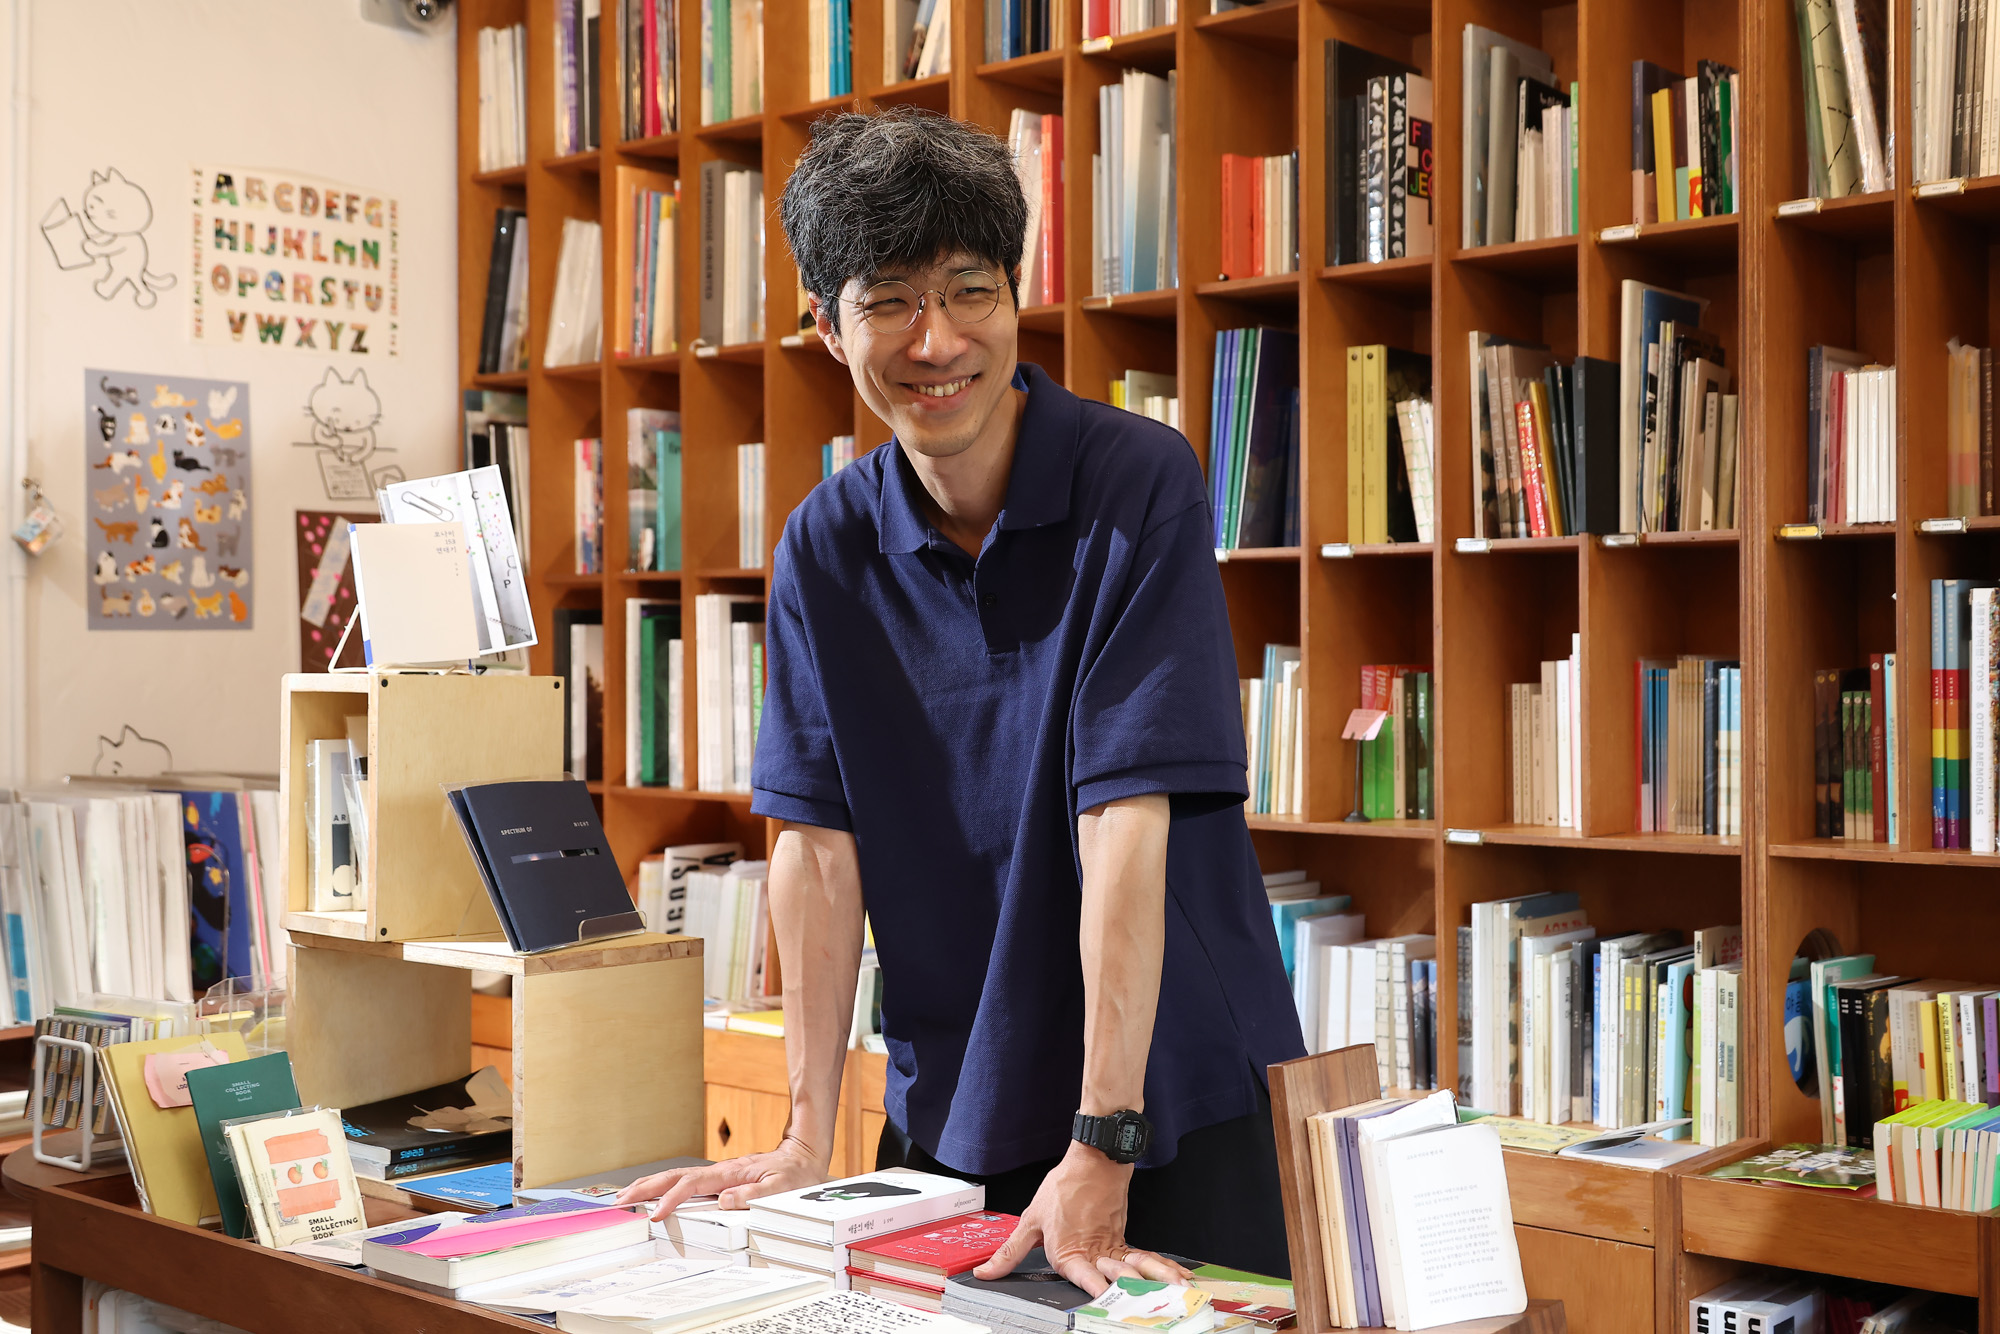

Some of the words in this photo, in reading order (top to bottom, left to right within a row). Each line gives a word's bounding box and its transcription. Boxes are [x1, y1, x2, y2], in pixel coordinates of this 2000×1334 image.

[214, 217, 380, 270] HIJKLMN
[211, 263, 383, 312] OPQRSTU
[226, 309, 368, 354] VWXYZ
[1494, 447, 1505, 480] Dying
[1508, 446, 1518, 479] Dying
[504, 579, 511, 588] P
[1976, 663, 1985, 692] TOYS
[1976, 701, 1984, 709] &
[1975, 712, 1984, 749] OTHER
[1975, 751, 1984, 816] MEMORIALS
[333, 814, 349, 822] AR
[501, 827, 526, 836] SPECTRUM
[225, 1083, 260, 1093] COLLECTING
[309, 1216, 334, 1225] SMALL
[311, 1217, 358, 1232] COLLECTING
[313, 1231, 334, 1240] BOOK
